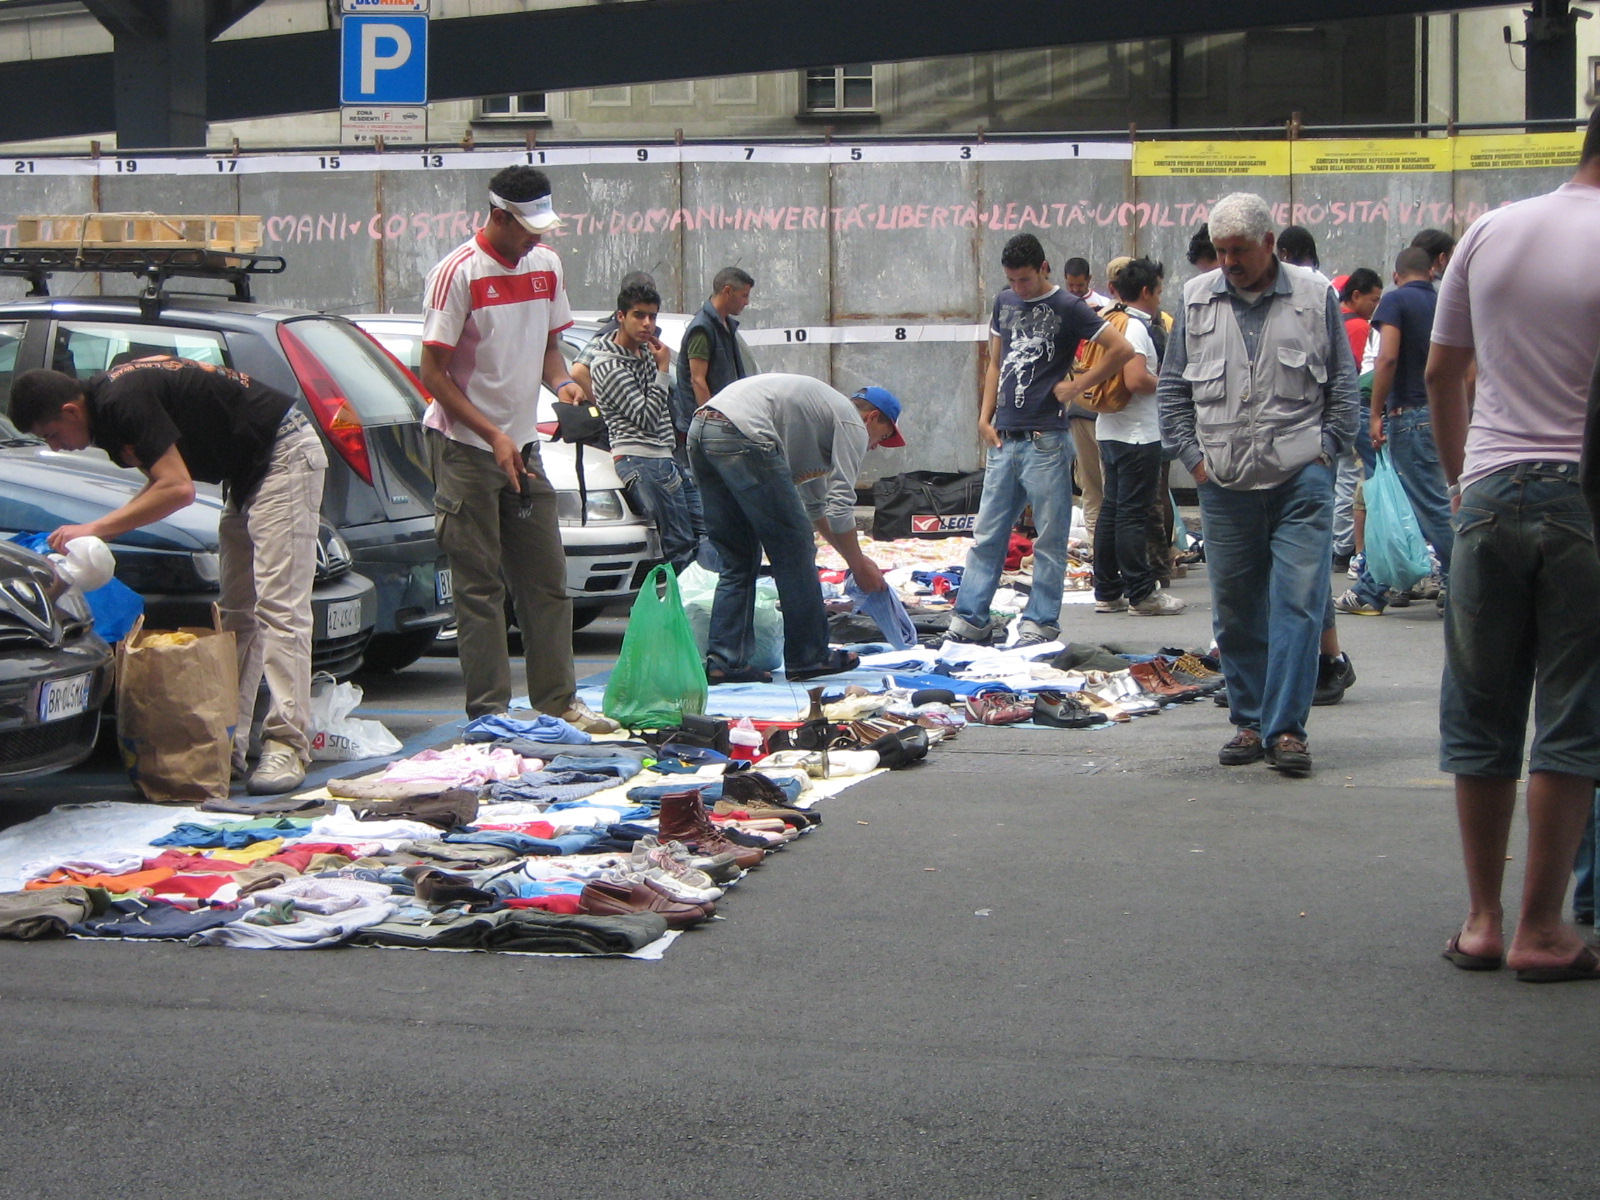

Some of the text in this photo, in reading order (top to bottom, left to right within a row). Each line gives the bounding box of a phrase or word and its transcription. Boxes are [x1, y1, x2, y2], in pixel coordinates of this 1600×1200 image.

[361, 23, 412, 94] P
[384, 112, 391, 121] F
[637, 149, 649, 162] 9
[744, 148, 755, 161] 7
[851, 148, 862, 161] 5
[960, 146, 972, 160] 3
[1071, 145, 1079, 157] 1
[319, 156, 341, 169] 15
[421, 155, 443, 168] 13
[526, 151, 546, 165] 11
[15, 161, 34, 173] 21
[116, 160, 137, 173] 19
[217, 160, 238, 172] 17
[266, 212, 347, 244] MANI
[368, 210, 491, 241] COSTRU
[608, 204, 725, 235] DOMANI
[875, 201, 979, 230] LIBERTÀ
[988, 201, 1089, 230] LEALTÀ
[784, 329, 807, 342] 10
[894, 327, 907, 341] 8
